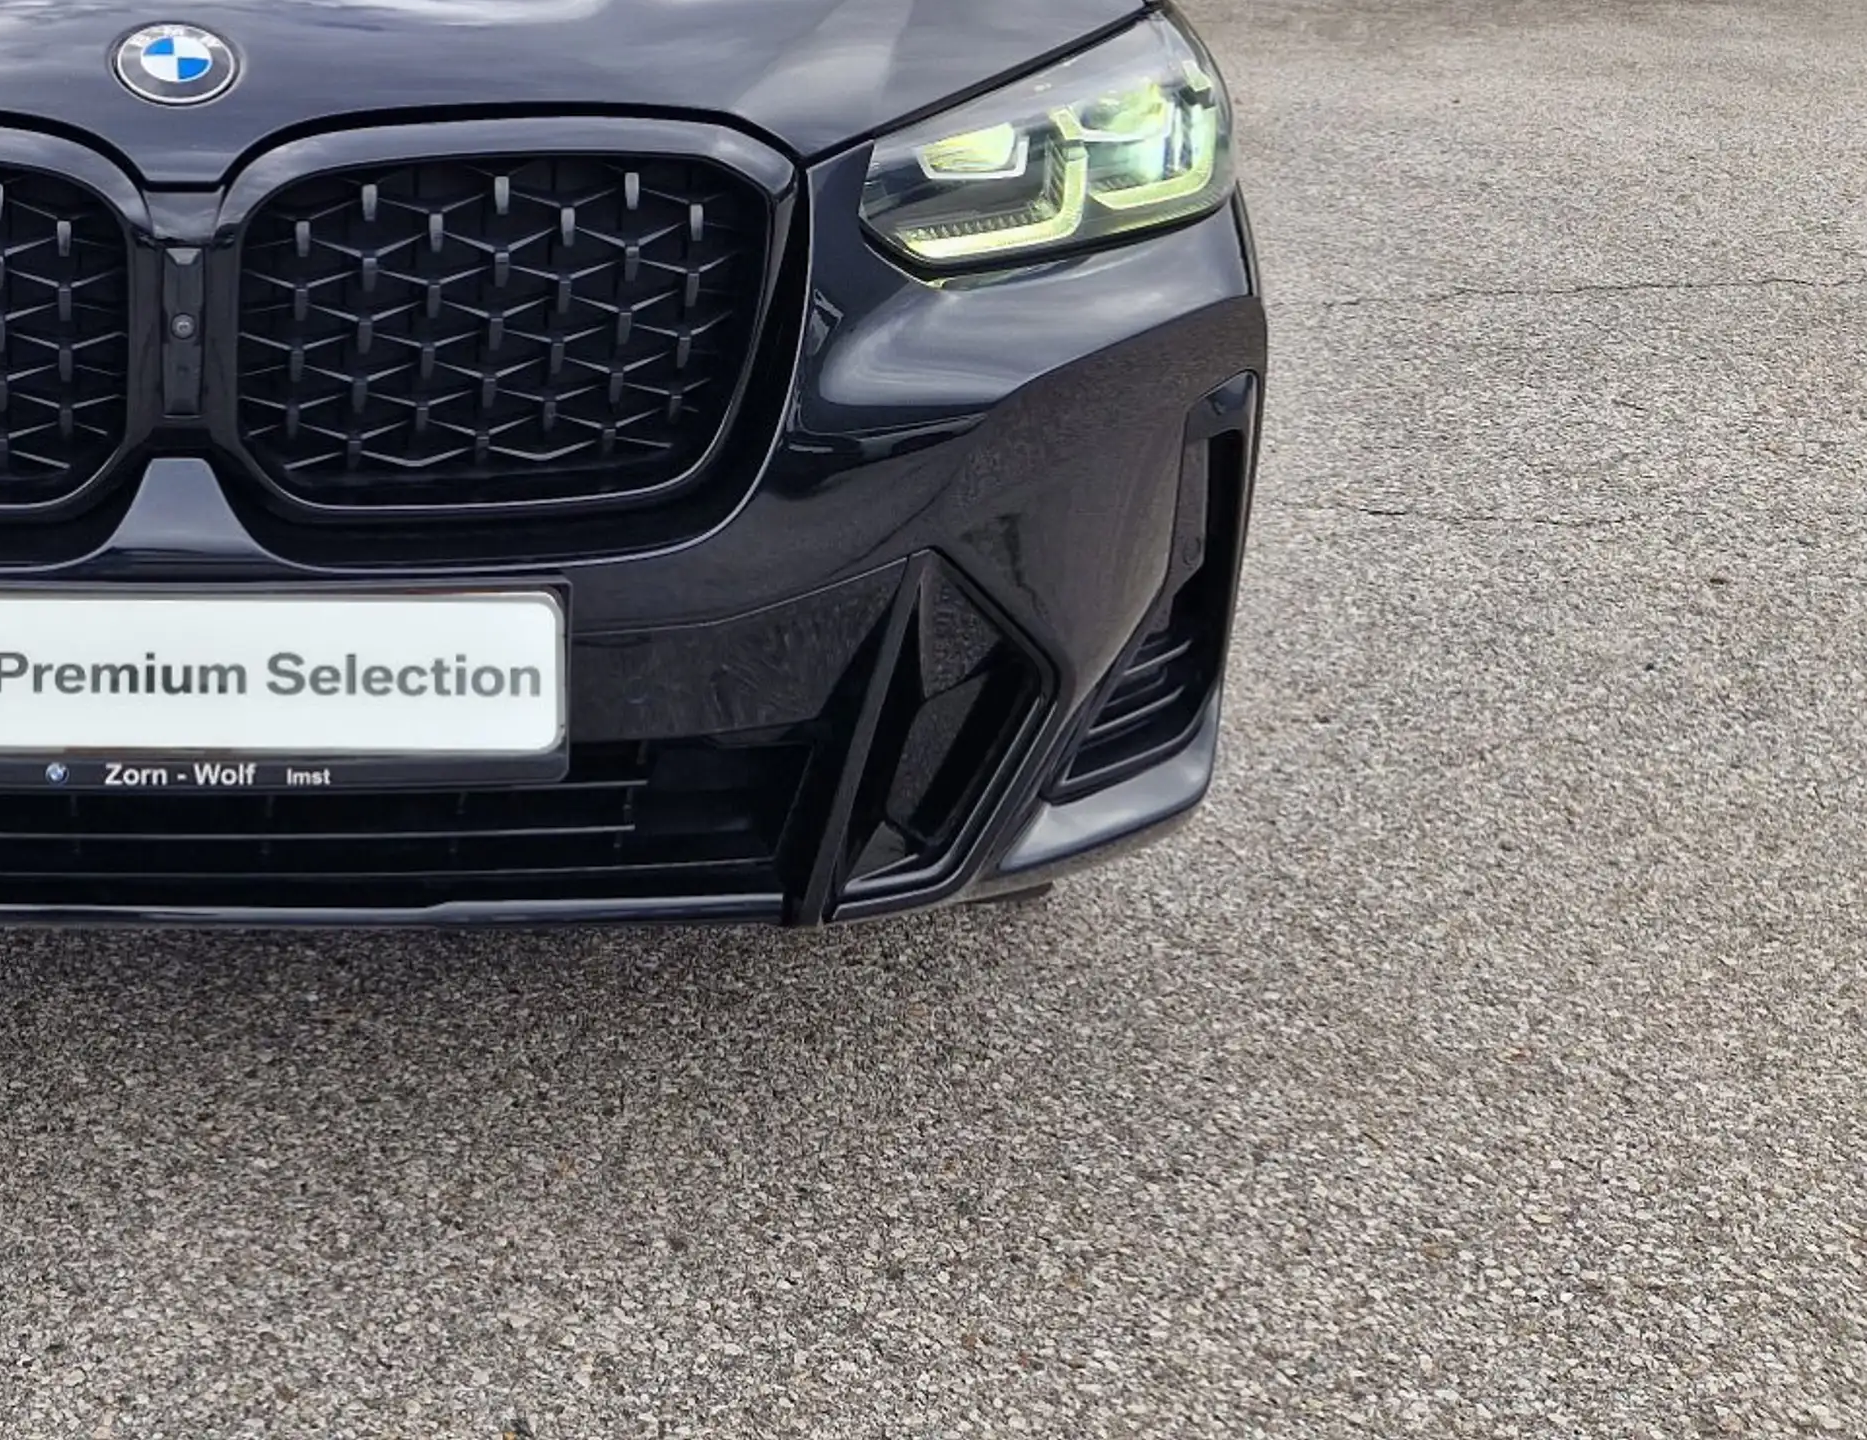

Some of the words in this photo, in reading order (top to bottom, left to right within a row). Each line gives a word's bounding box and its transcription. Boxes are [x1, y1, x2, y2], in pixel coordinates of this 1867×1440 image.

[266, 652, 541, 698] Selection
[104, 762, 168, 786] Zorn
[193, 762, 257, 786] Wolf
[286, 767, 331, 786] Imst
